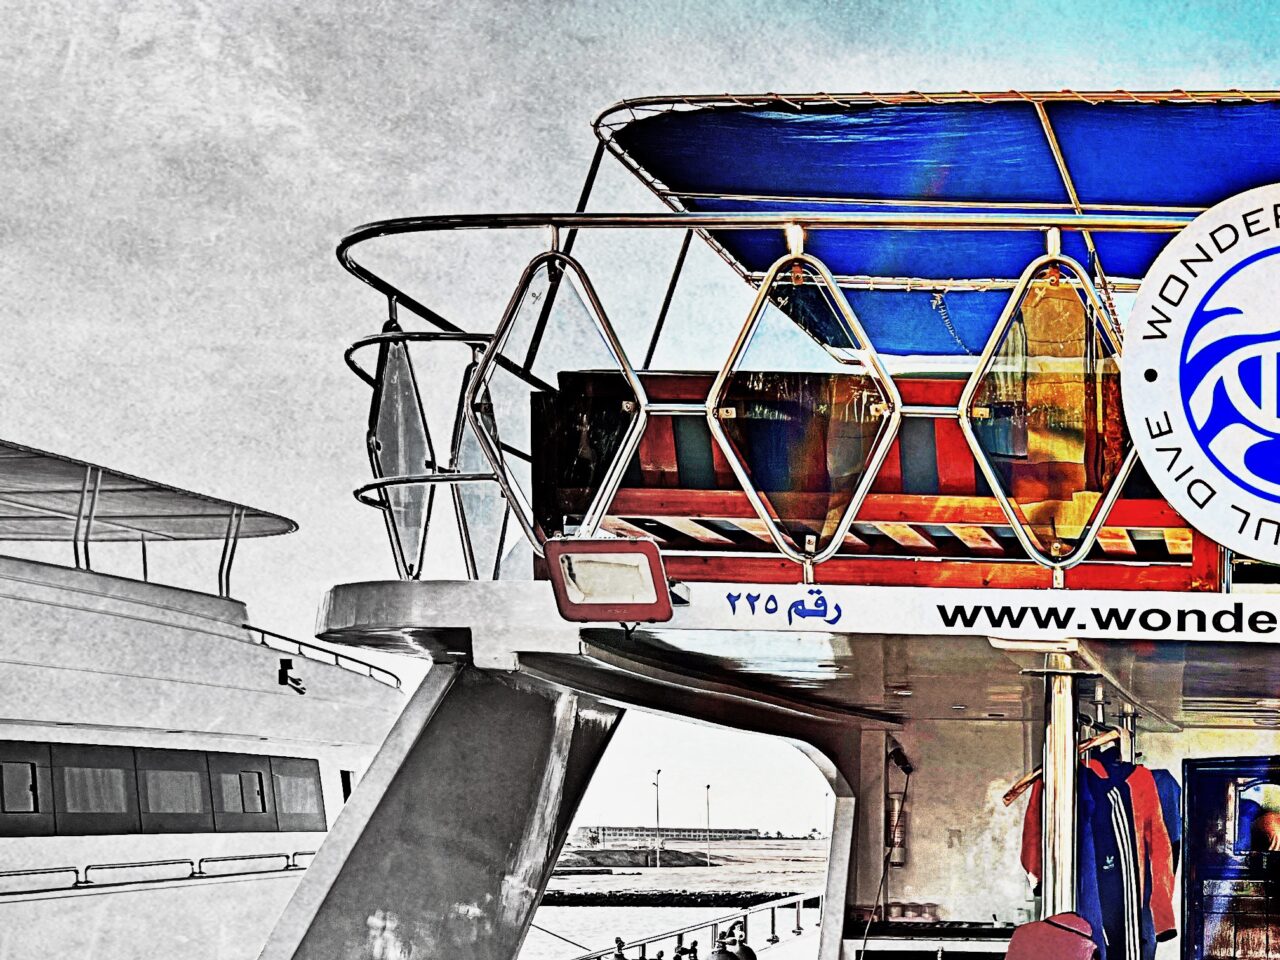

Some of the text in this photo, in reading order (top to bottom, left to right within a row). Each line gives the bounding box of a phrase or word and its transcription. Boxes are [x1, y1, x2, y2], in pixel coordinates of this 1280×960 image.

[1144, 411, 1217, 509] DIVE
[725, 588, 842, 626] رقم ٢٢٥
